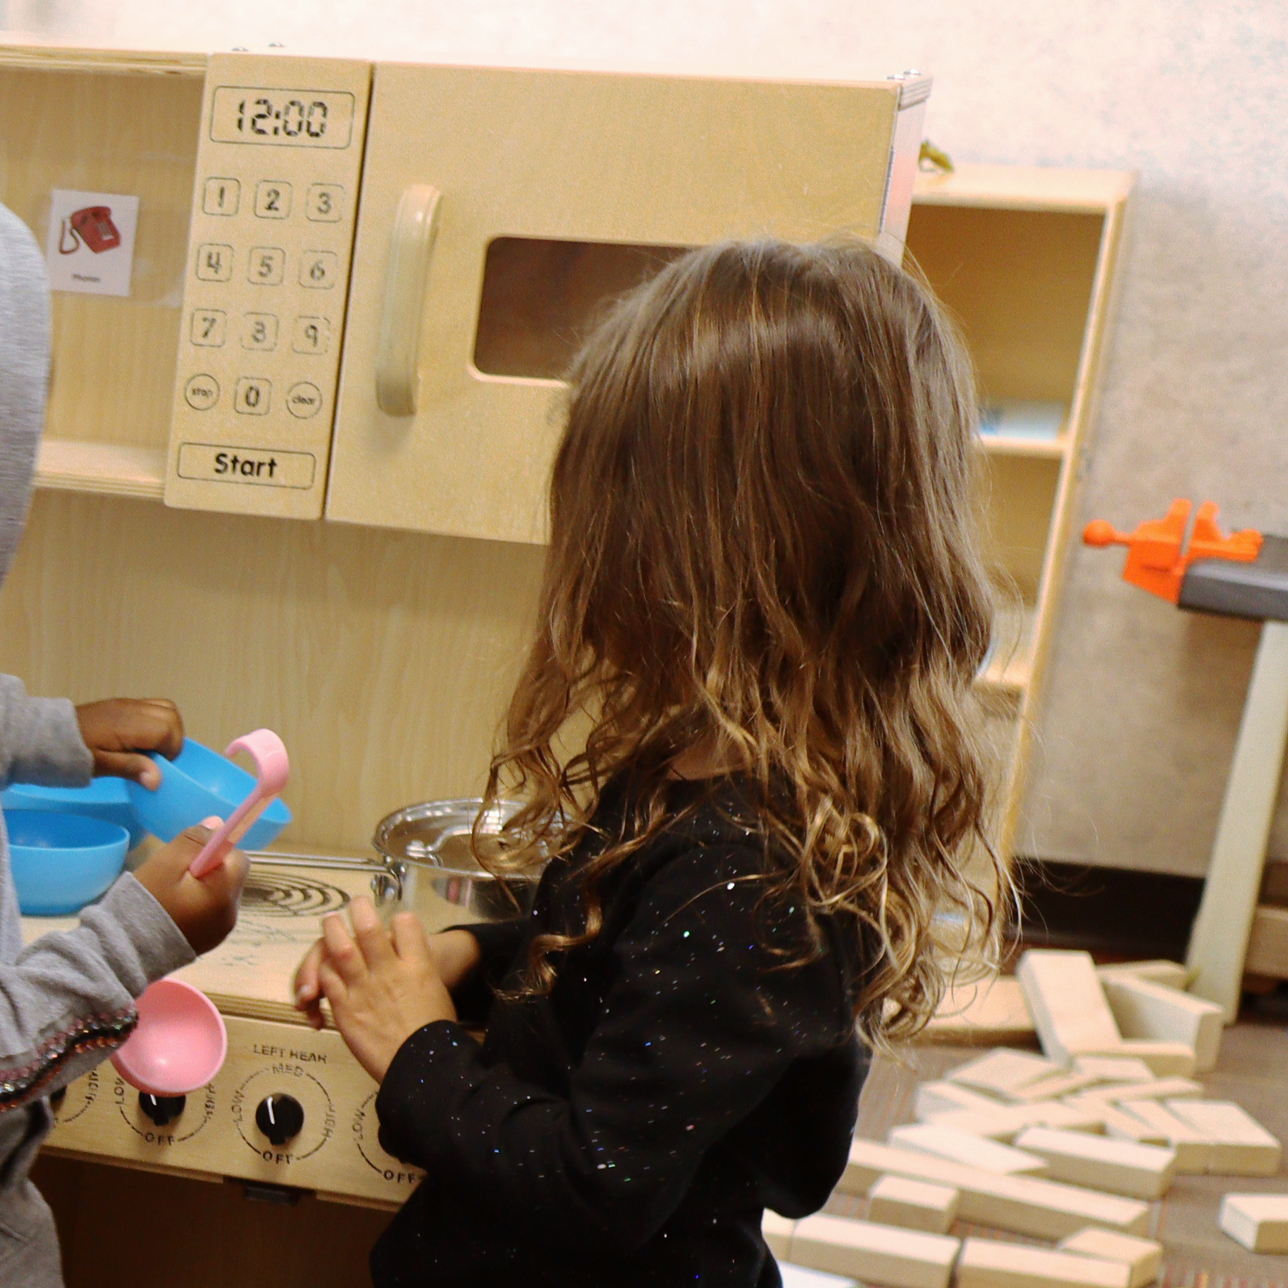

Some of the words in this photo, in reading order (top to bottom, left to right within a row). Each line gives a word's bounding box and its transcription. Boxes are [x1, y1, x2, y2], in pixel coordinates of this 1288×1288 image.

[236, 98, 328, 138] 12:00
[218, 186, 225, 208] 1
[265, 188, 280, 211] 2
[317, 192, 331, 214] 3
[206, 251, 221, 274] 4
[259, 255, 273, 277] 5
[310, 258, 325, 280] 6
[202, 317, 217, 339] 7
[305, 324, 318, 347] 9
[245, 386, 259, 407] 0
[214, 452, 277, 479] Start
[253, 1044, 286, 1057] LEFT
[231, 1091, 245, 1125] LOW
[145, 1132, 175, 1145] OFF
[384, 1170, 417, 1183] OFF
